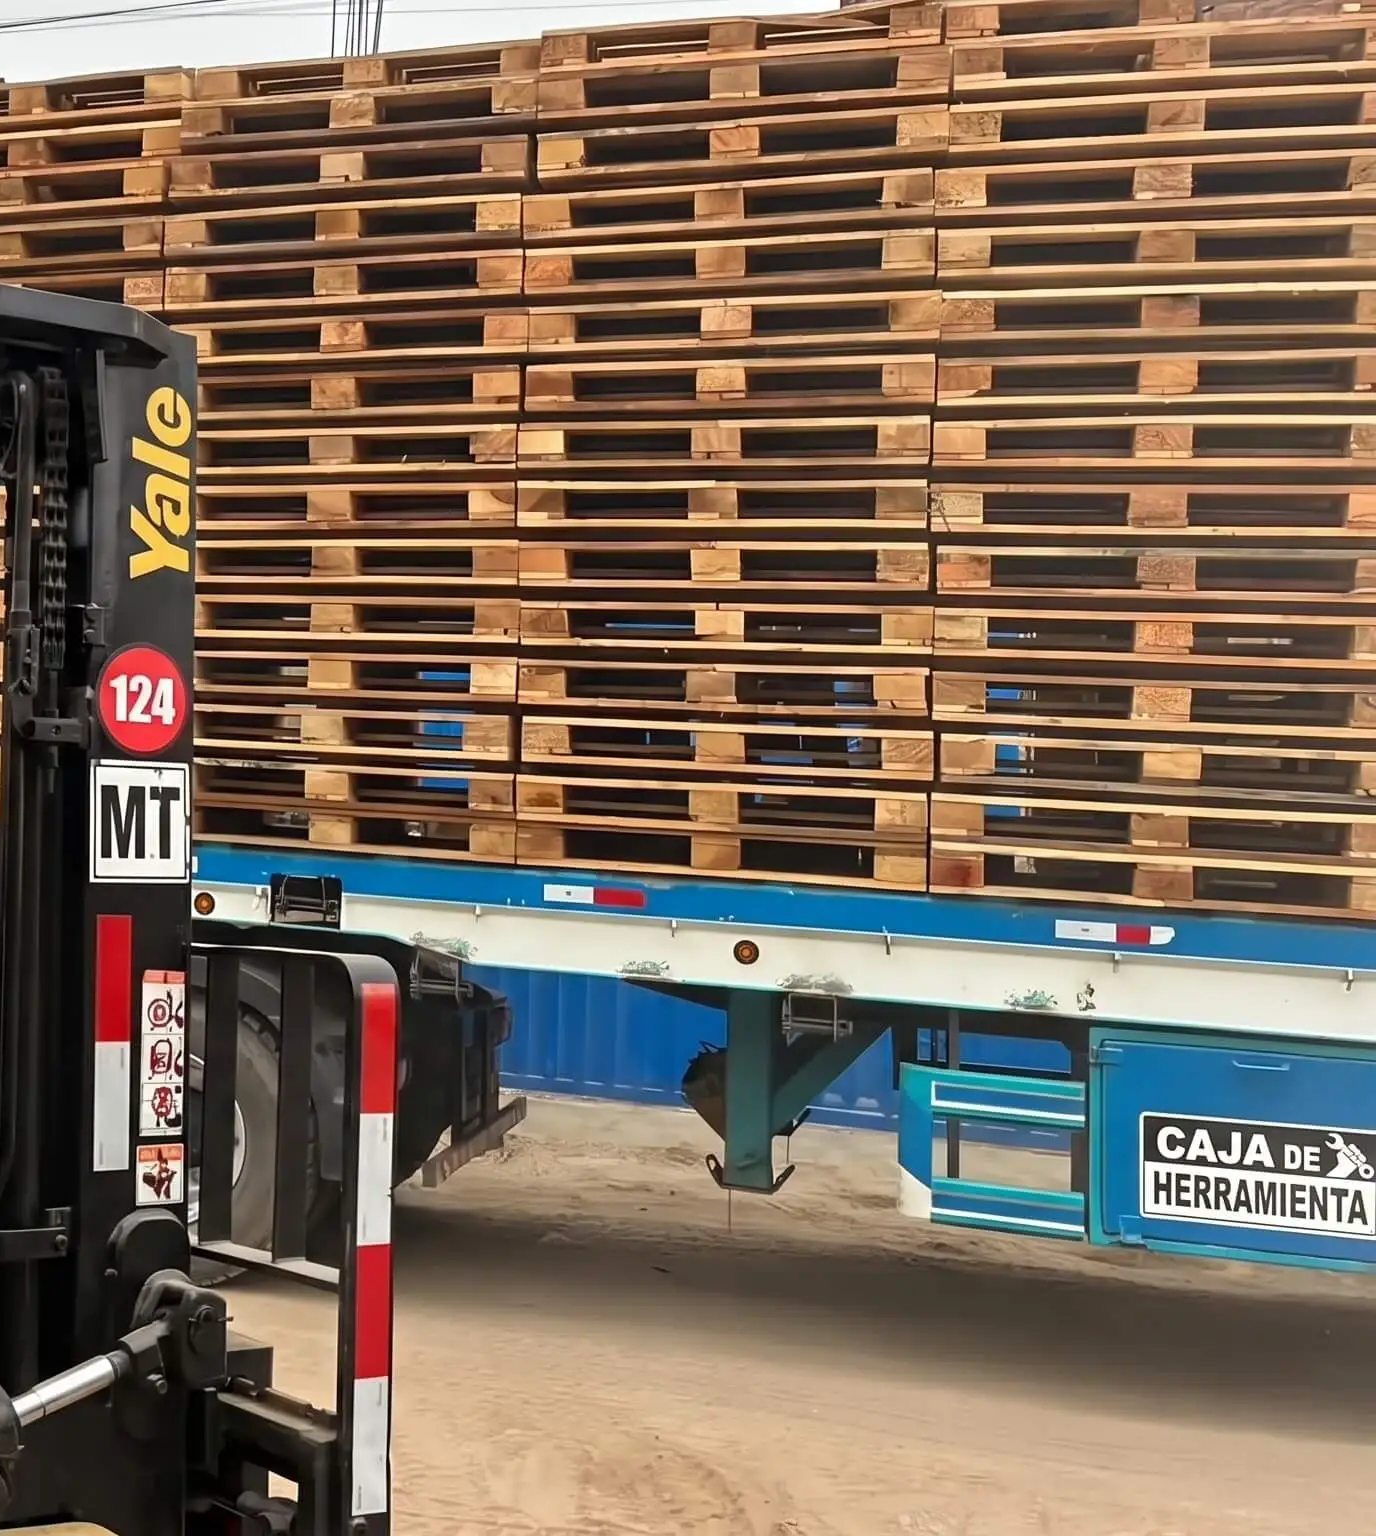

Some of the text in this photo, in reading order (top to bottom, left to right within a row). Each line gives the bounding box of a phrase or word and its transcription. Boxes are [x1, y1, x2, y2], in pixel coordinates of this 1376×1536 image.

[129, 385, 192, 580] Yale
[109, 673, 176, 725] 124
[100, 784, 181, 860] MT
[1156, 1125, 1321, 1173] CAJA DE
[1153, 1170, 1369, 1226] HERRAMIENTA
